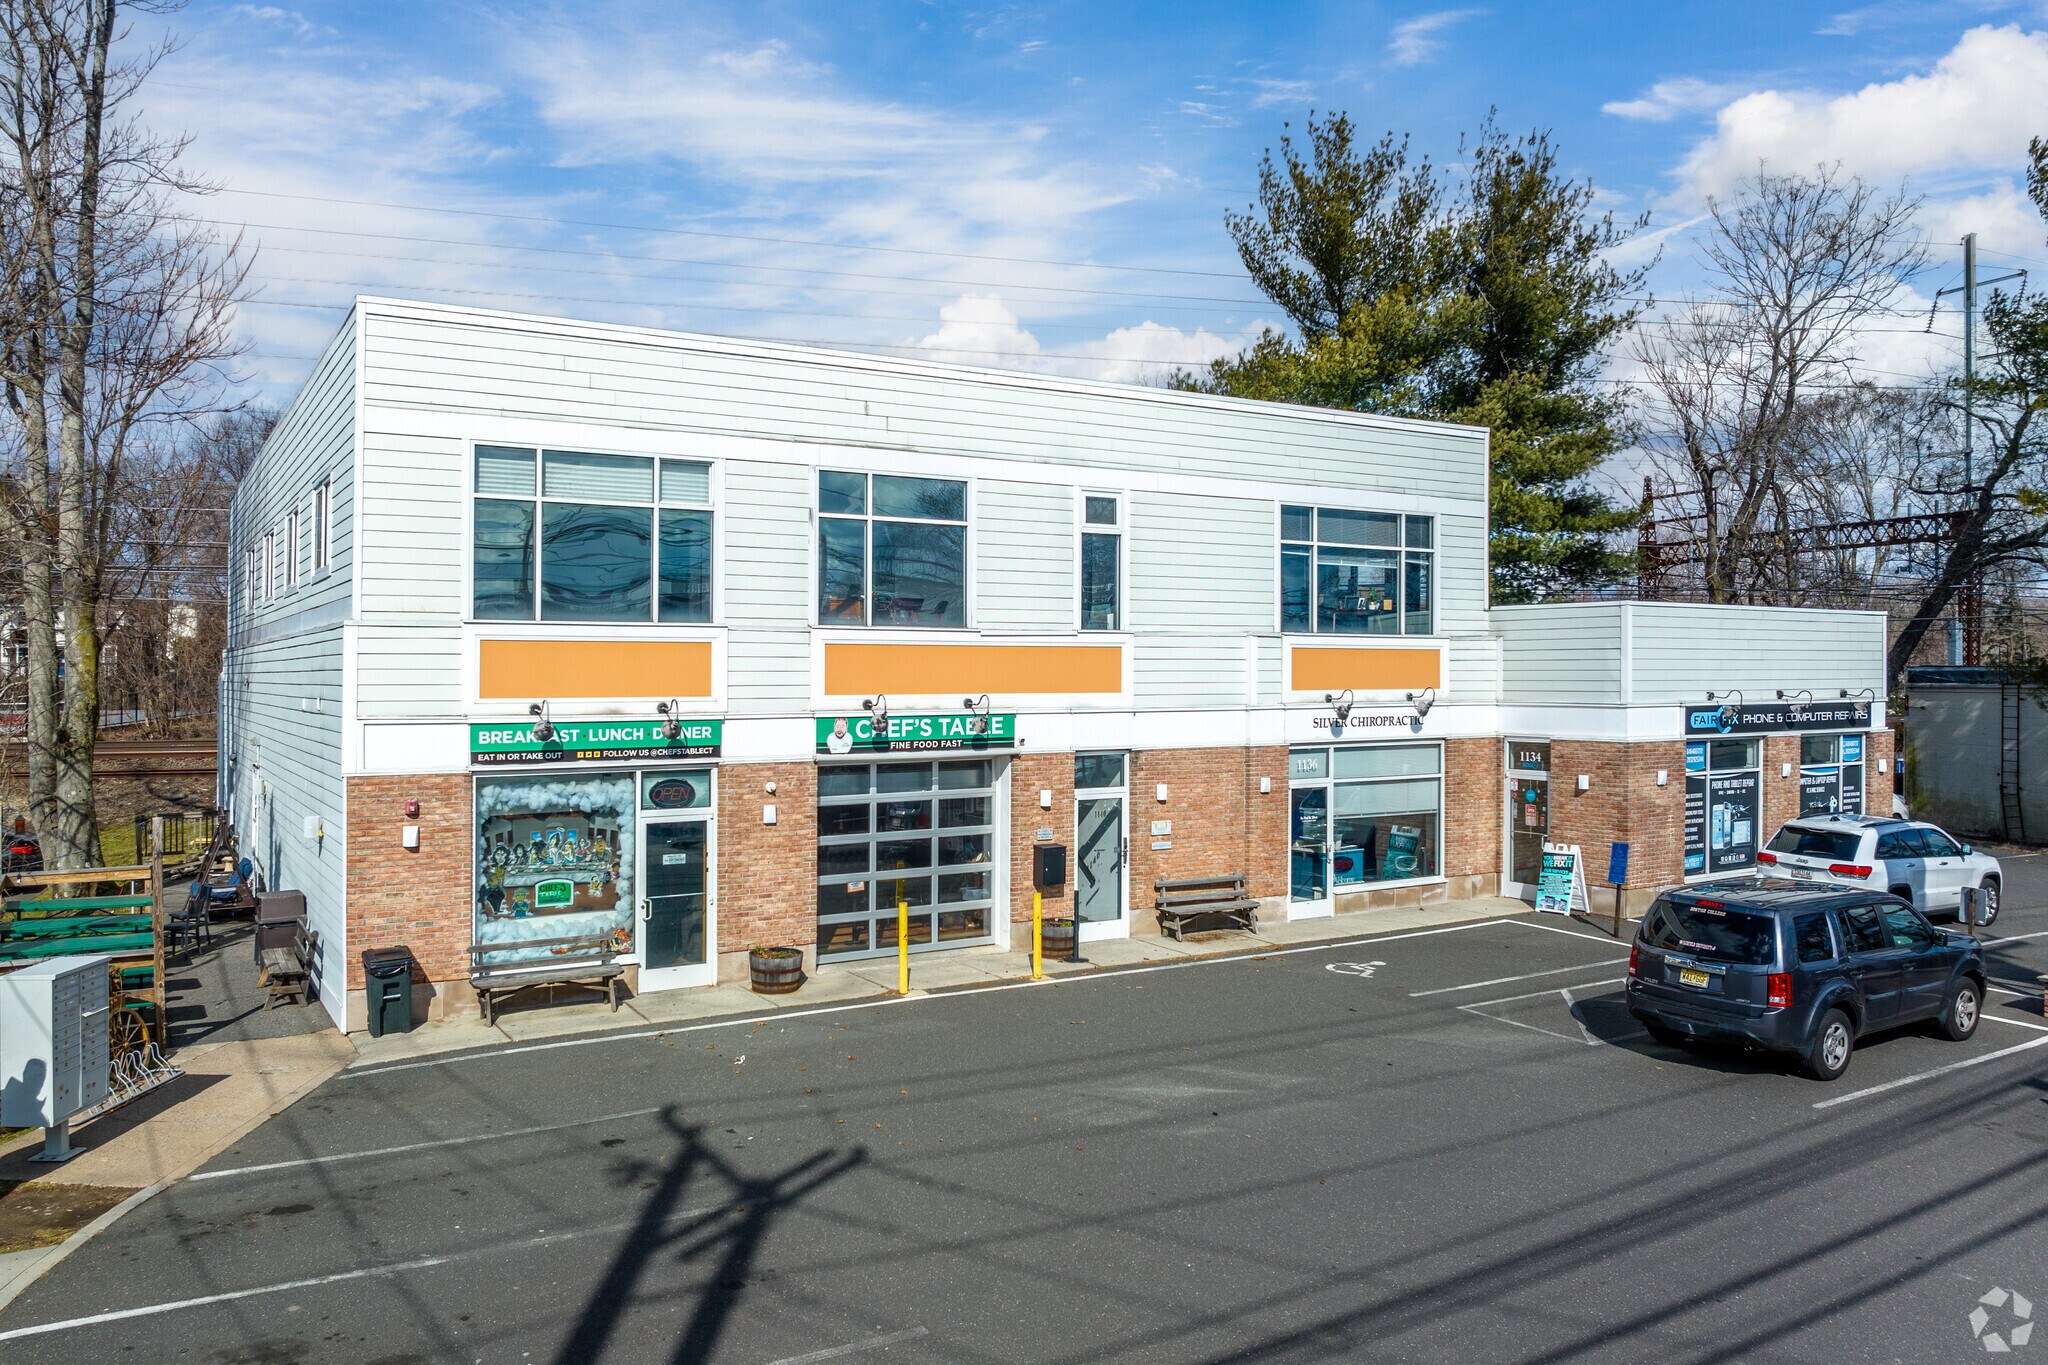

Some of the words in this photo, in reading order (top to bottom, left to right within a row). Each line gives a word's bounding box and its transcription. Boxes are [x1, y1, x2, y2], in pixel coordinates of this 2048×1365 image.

[1312, 716, 1348, 729] SILVER
[1350, 715, 1425, 728] CHIROPRACTIC
[1693, 715, 1717, 725] FAIR
[1743, 713, 1775, 723] PHONE
[1777, 713, 1784, 722] &
[1786, 712, 1832, 722] COMPUTER
[1834, 710, 1868, 720] REPAIRS
[855, 718, 933, 739] CEF'S
[478, 729, 580, 745] BREAKAST
[588, 727, 644, 742] LUNCH
[890, 741, 911, 749] FINE
[913, 740, 939, 749] FOOD
[941, 739, 963, 748] FAST
[477, 753, 495, 761] EAT
[496, 753, 506, 761] IN
[521, 752, 543, 760] TAKE
[544, 751, 562, 759] OUT
[603, 750, 637, 758] FOLLOW
[638, 749, 649, 757] US
[650, 747, 713, 758] @CHEFSTABLECT
[1520, 751, 1541, 763] 1134
[1297, 758, 1318, 770] 1136
[652, 786, 690, 801] OPEN
[1543, 860, 1554, 868] WE
[1554, 860, 1566, 868] FIX
[539, 883, 567, 892] CHEF'S
